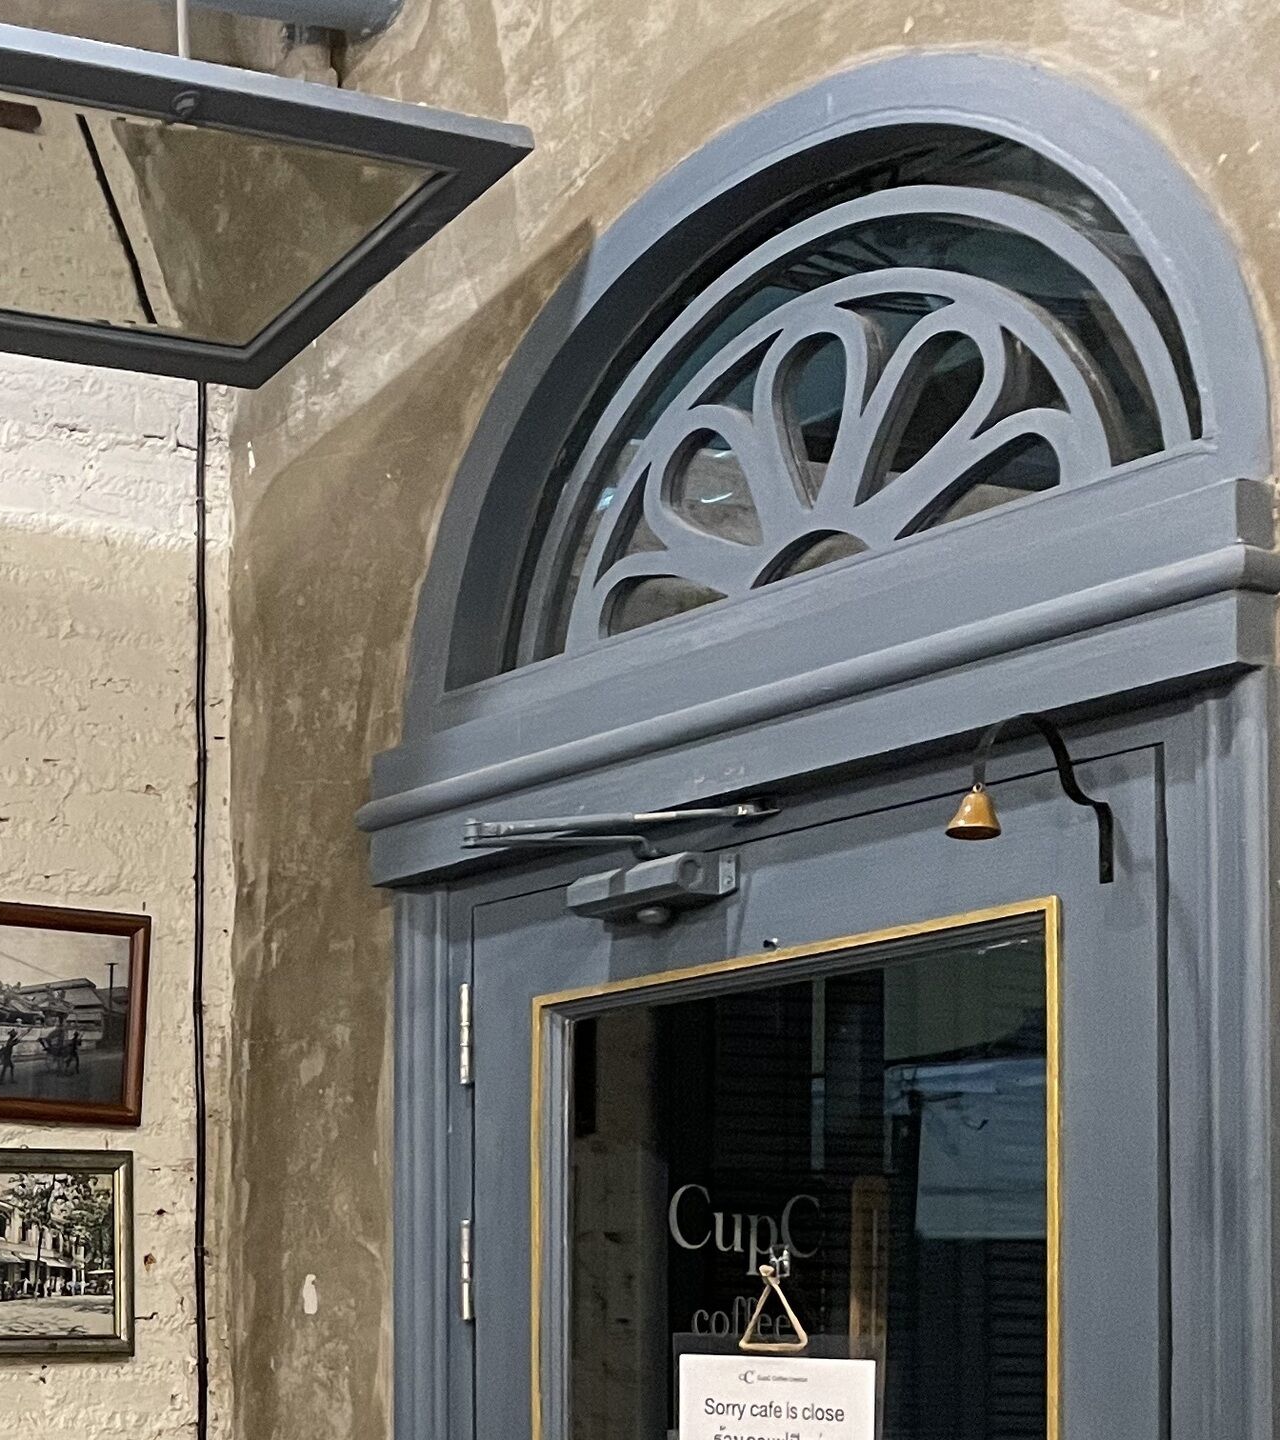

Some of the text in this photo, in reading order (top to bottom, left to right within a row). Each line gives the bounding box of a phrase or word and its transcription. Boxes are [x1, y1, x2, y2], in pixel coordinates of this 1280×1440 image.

[669, 1183, 821, 1276] CupC
[691, 1295, 792, 1338] coffee
[704, 1398, 845, 1422] Sorry cafe is close
